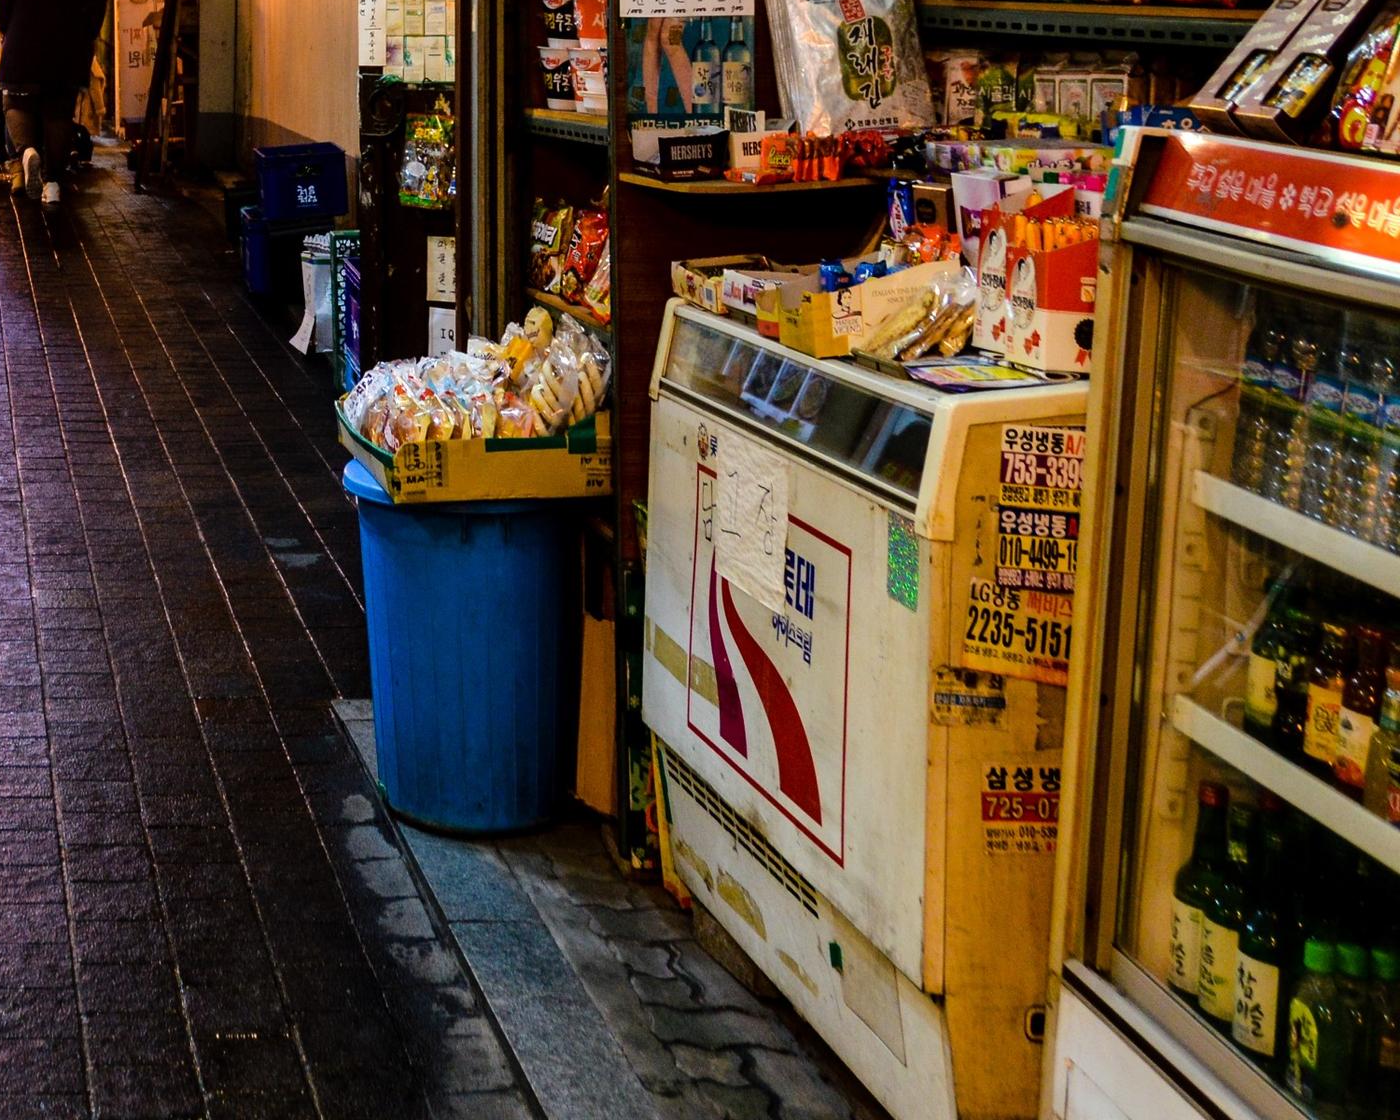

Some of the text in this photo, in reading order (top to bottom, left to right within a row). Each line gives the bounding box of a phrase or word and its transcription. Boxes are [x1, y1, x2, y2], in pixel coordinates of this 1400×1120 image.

[848, 16, 882, 110] 재래김
[670, 143, 713, 161] HERSHEY'S
[1005, 428, 1064, 455] 우성냉동
[1001, 510, 1067, 538] 우성냉동
[970, 582, 1021, 612] LG냉동
[966, 605, 1073, 661] 2235-5151
